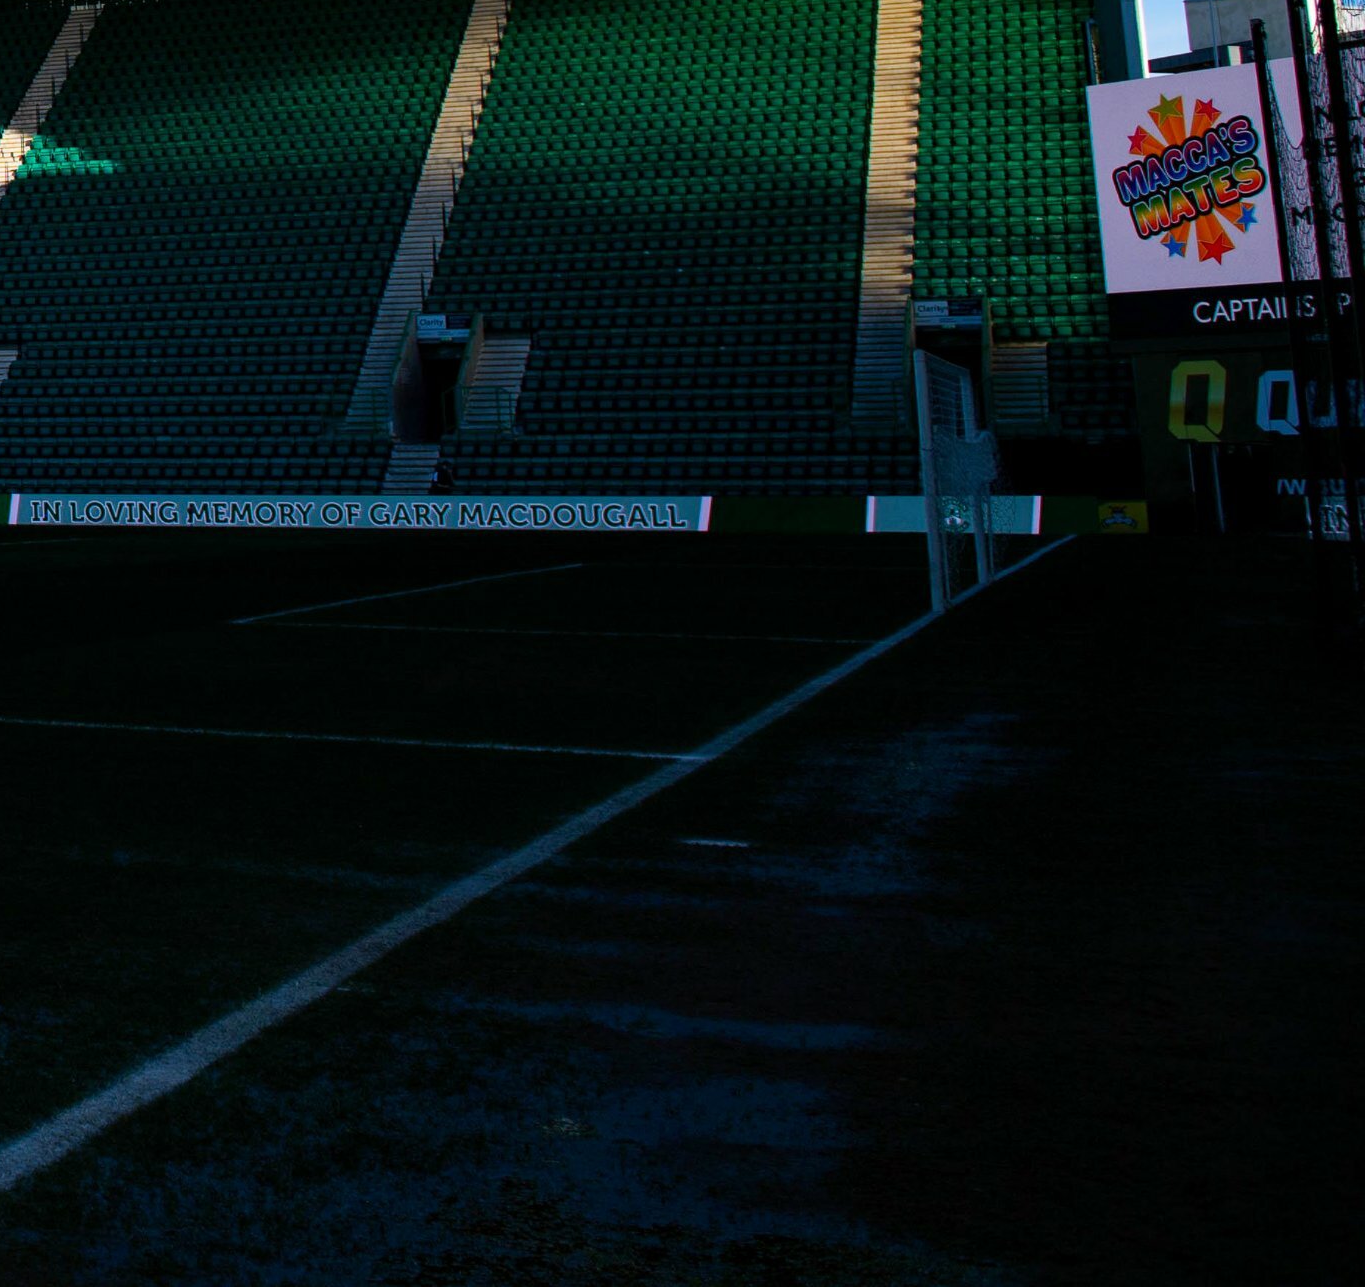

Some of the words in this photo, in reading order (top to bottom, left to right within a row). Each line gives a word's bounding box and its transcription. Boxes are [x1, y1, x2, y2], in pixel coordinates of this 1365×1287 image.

[1113, 115, 1258, 206] MACCA'S
[1129, 153, 1266, 239] MATES
[419, 317, 446, 328] Clarity
[1167, 359, 1227, 443] Q
[31, 501, 62, 522] IN
[70, 501, 179, 523] LOVING
[186, 502, 315, 525] MEMORY
[321, 503, 360, 526] OF
[368, 503, 450, 527] GARY
[457, 503, 689, 528] MACDOUGALL
